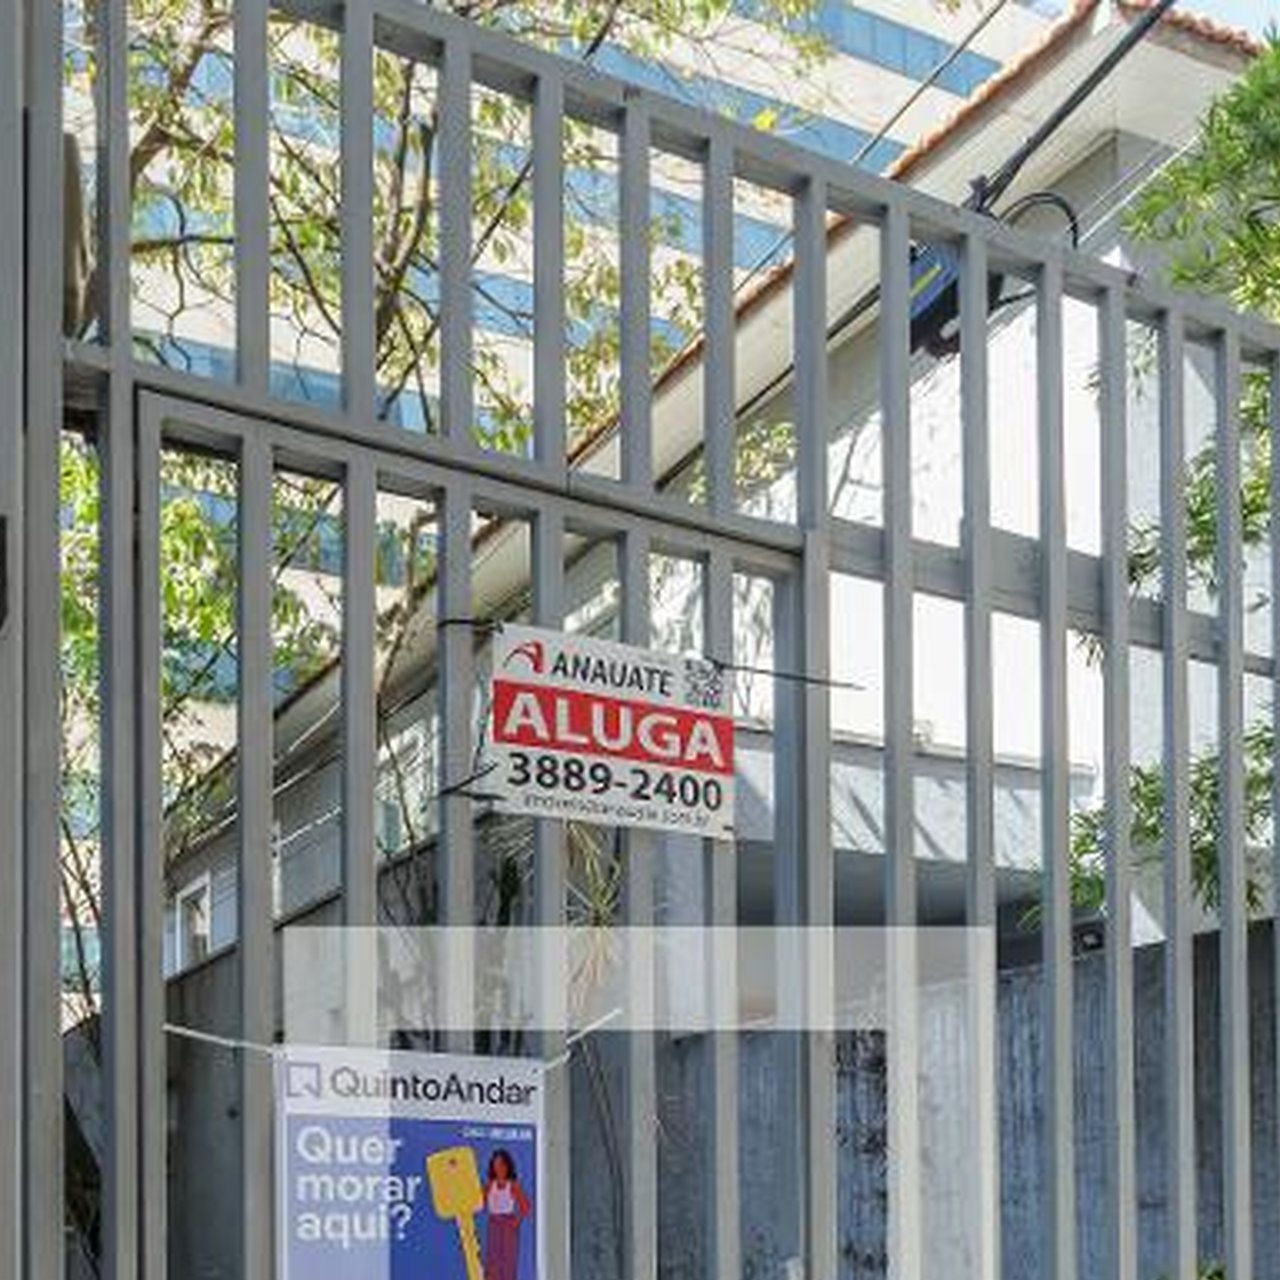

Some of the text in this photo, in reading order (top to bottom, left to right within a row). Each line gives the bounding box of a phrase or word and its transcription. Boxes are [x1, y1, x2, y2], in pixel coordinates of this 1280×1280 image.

[552, 652, 673, 698] ANAUATE
[502, 691, 724, 768] ALUGA
[506, 751, 722, 812] 3889-2400
[330, 1066, 538, 1105] QuintoAndar
[296, 1126, 403, 1164] Quer
[296, 1174, 422, 1203] morar
[296, 1205, 413, 1248] aqui?
